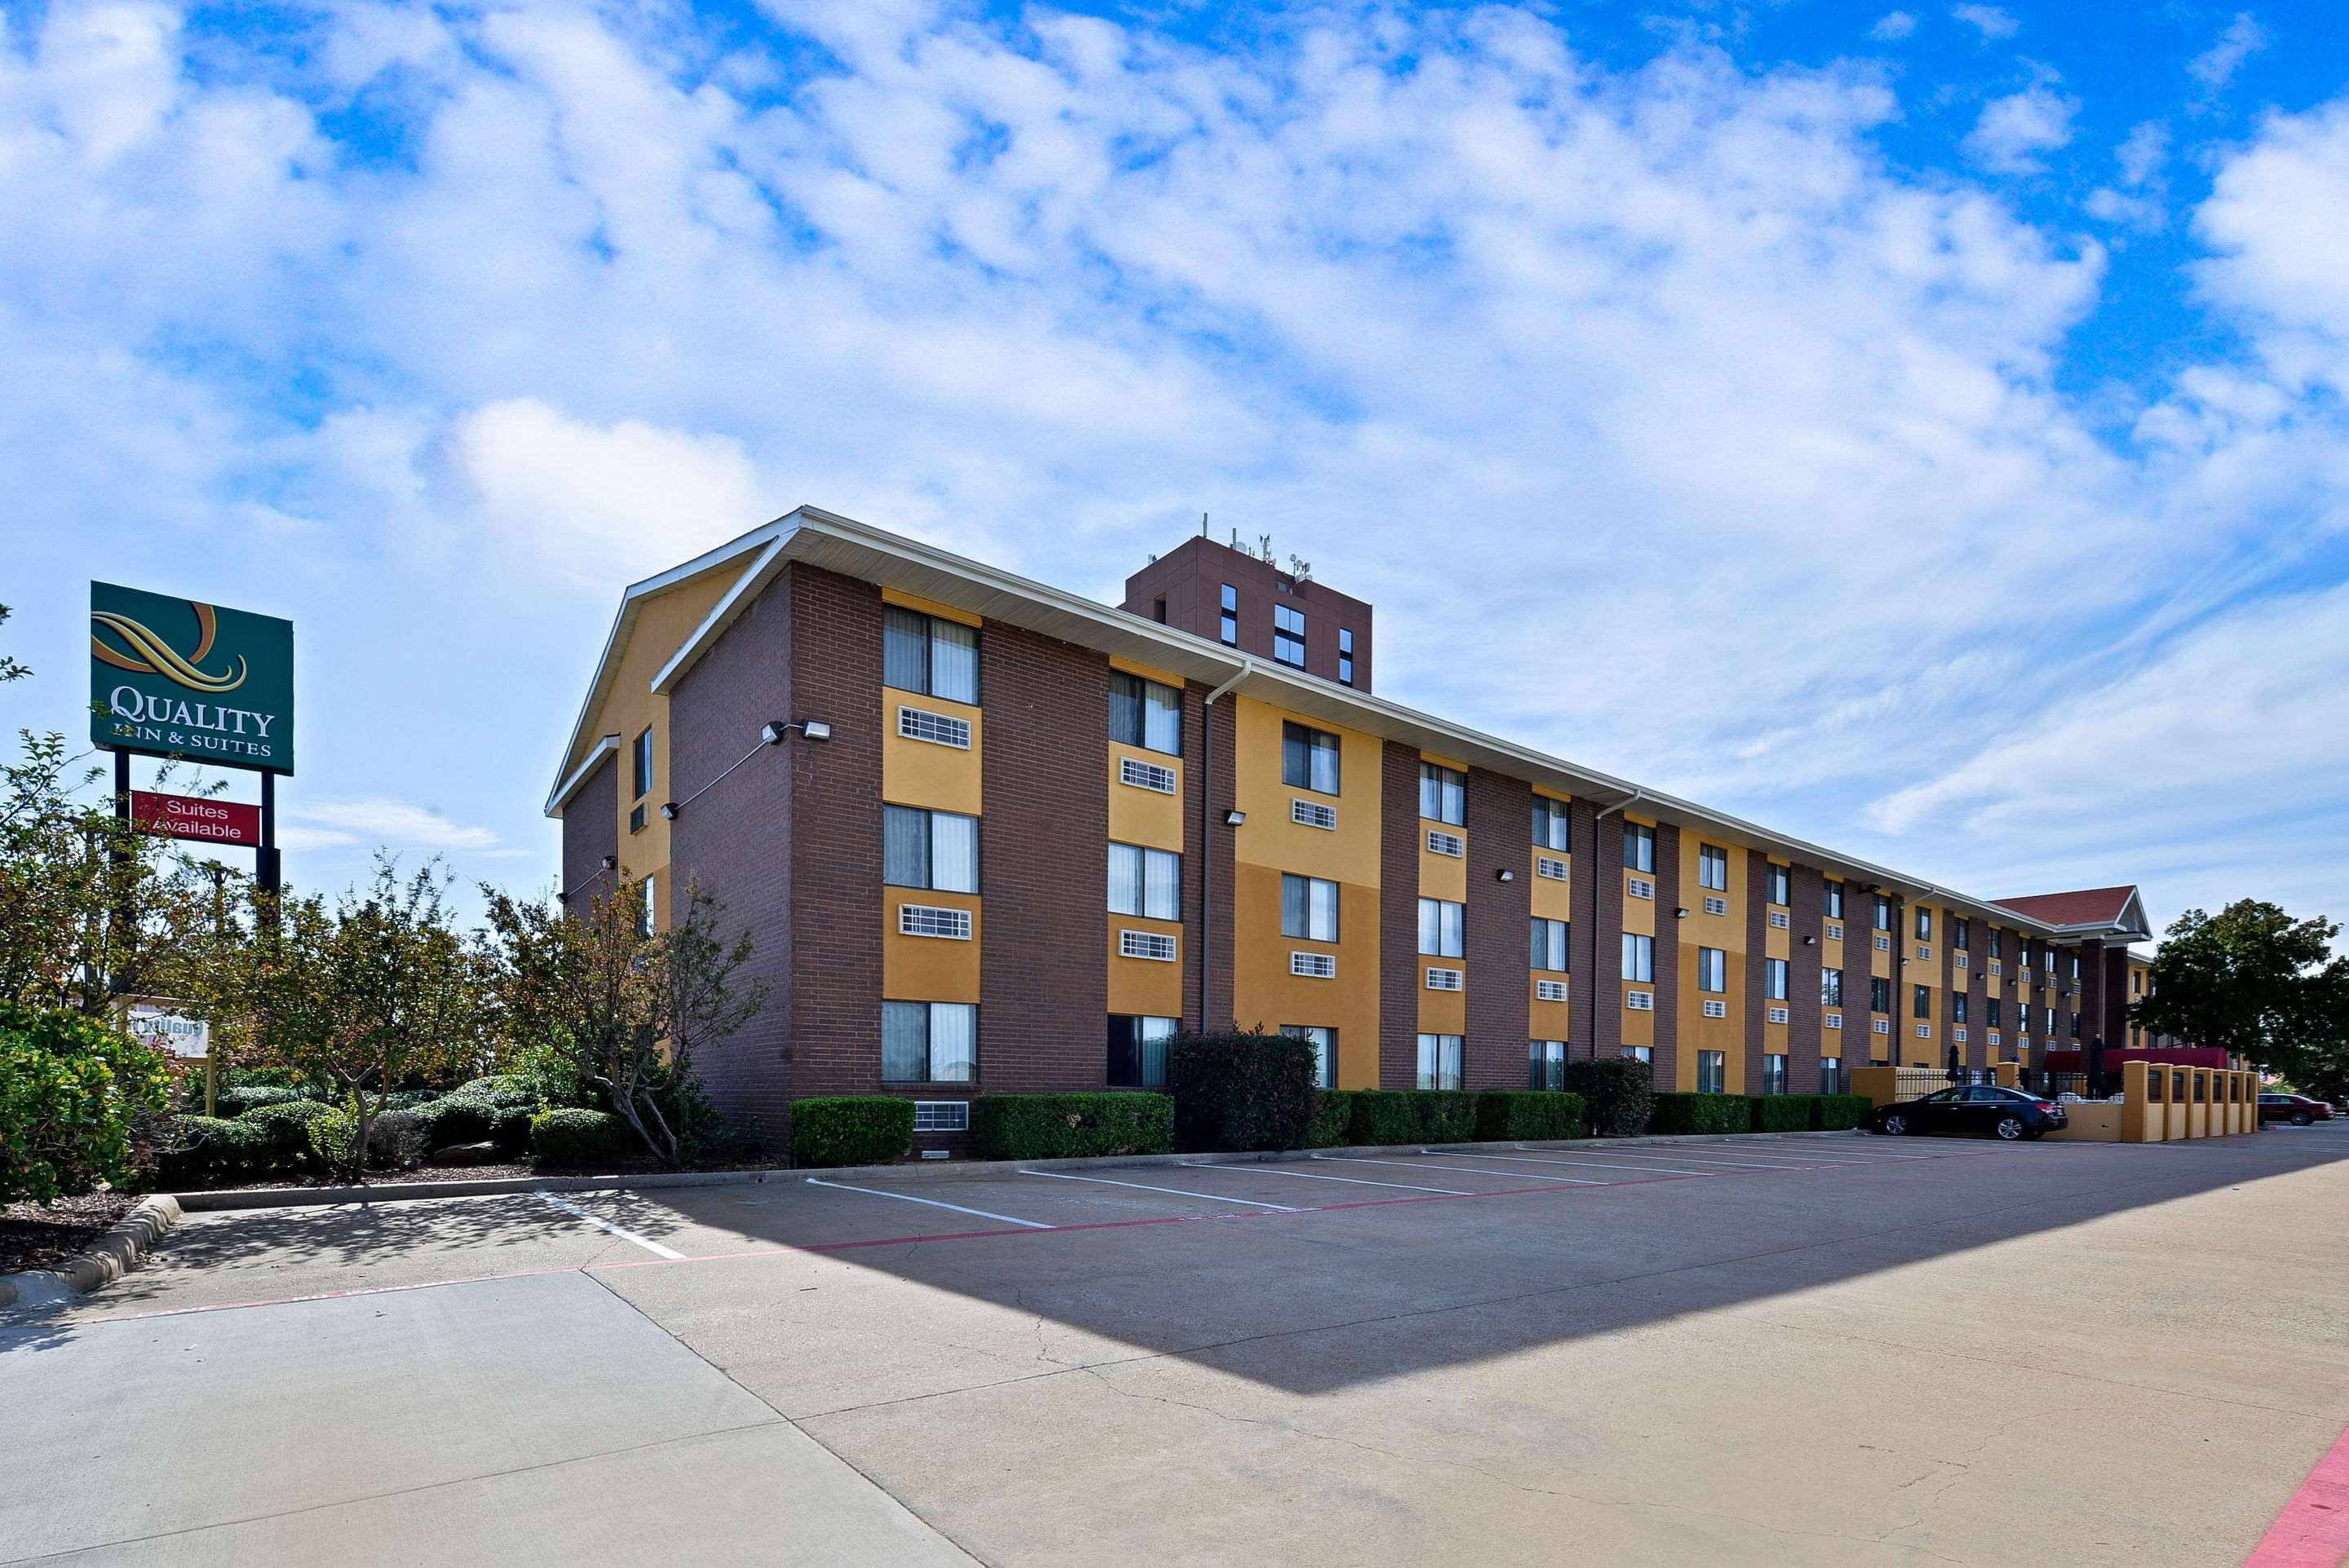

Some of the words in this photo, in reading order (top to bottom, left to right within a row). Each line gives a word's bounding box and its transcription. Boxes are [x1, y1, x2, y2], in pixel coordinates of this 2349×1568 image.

[110, 686, 275, 737] QUALITY
[168, 731, 184, 744] &
[191, 735, 272, 756] SUITES
[166, 800, 228, 819] Suites
[153, 816, 241, 838] Available
